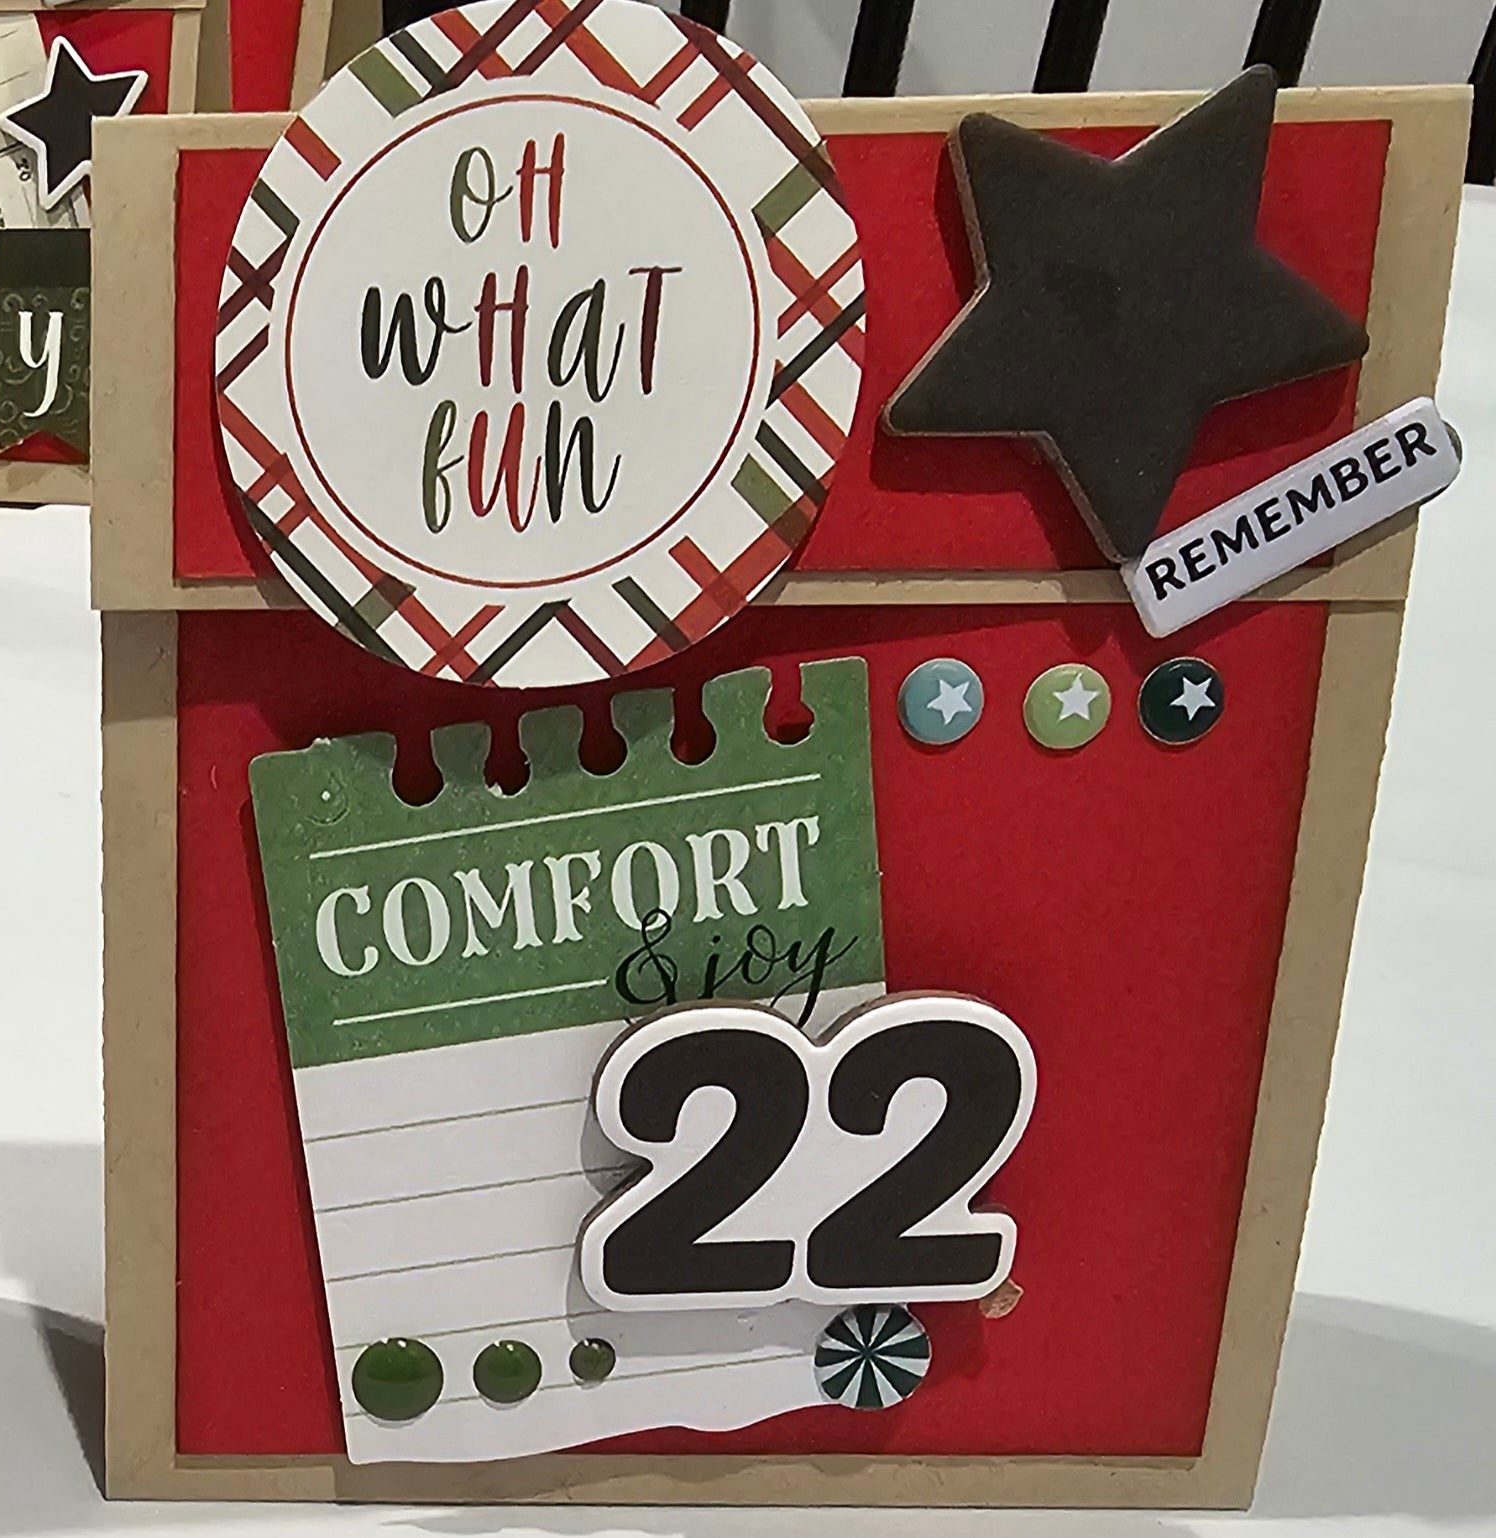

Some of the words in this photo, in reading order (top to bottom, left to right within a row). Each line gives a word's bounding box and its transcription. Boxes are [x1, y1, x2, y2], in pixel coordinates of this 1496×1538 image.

[15, 158, 32, 182] TO
[449, 132, 566, 249] OH
[1144, 421, 1438, 601] REMEMBER
[314, 814, 821, 977] COMFORT
[615, 908, 679, 1006] &
[697, 924, 860, 1029] joy
[603, 1019, 1022, 1295] 22
